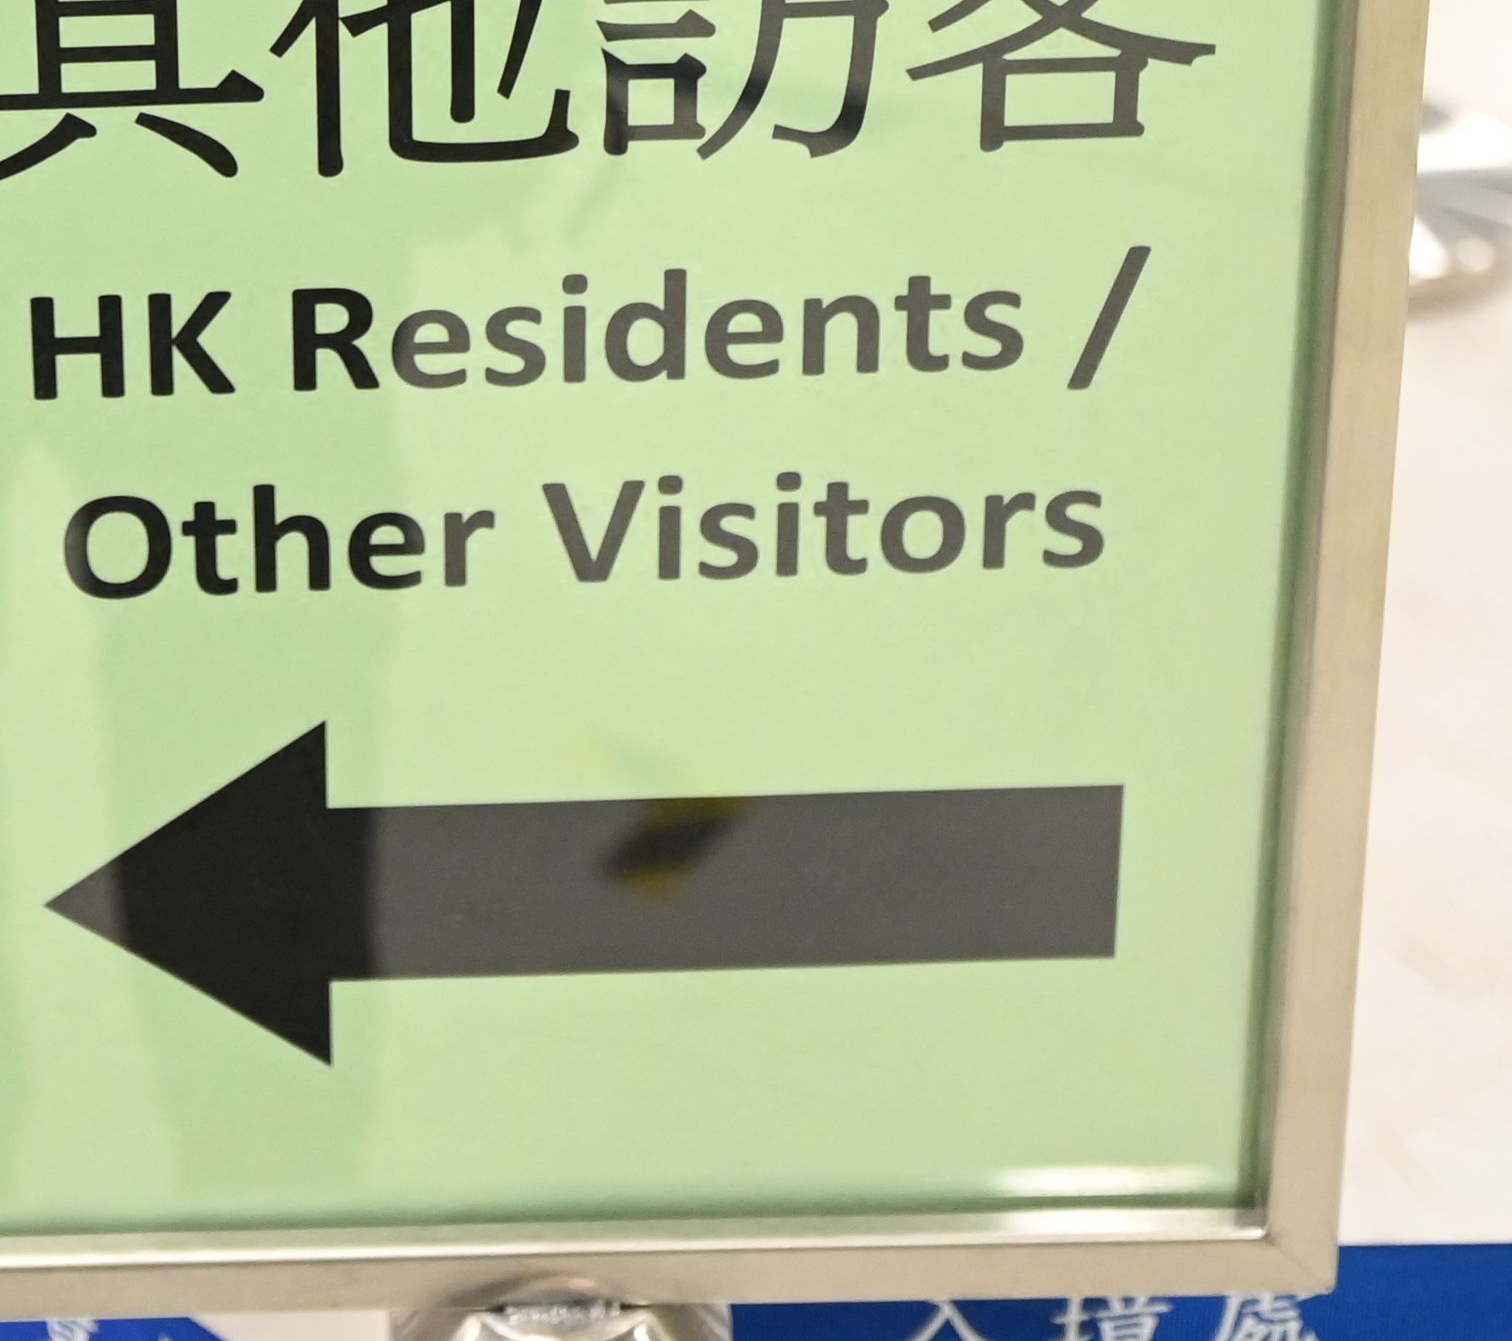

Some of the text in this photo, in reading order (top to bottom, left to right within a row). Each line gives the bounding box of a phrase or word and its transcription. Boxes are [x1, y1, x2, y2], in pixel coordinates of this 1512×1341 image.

[29, 245, 1152, 401] HK Residents /
[64, 471, 1105, 600] Other Visitors
